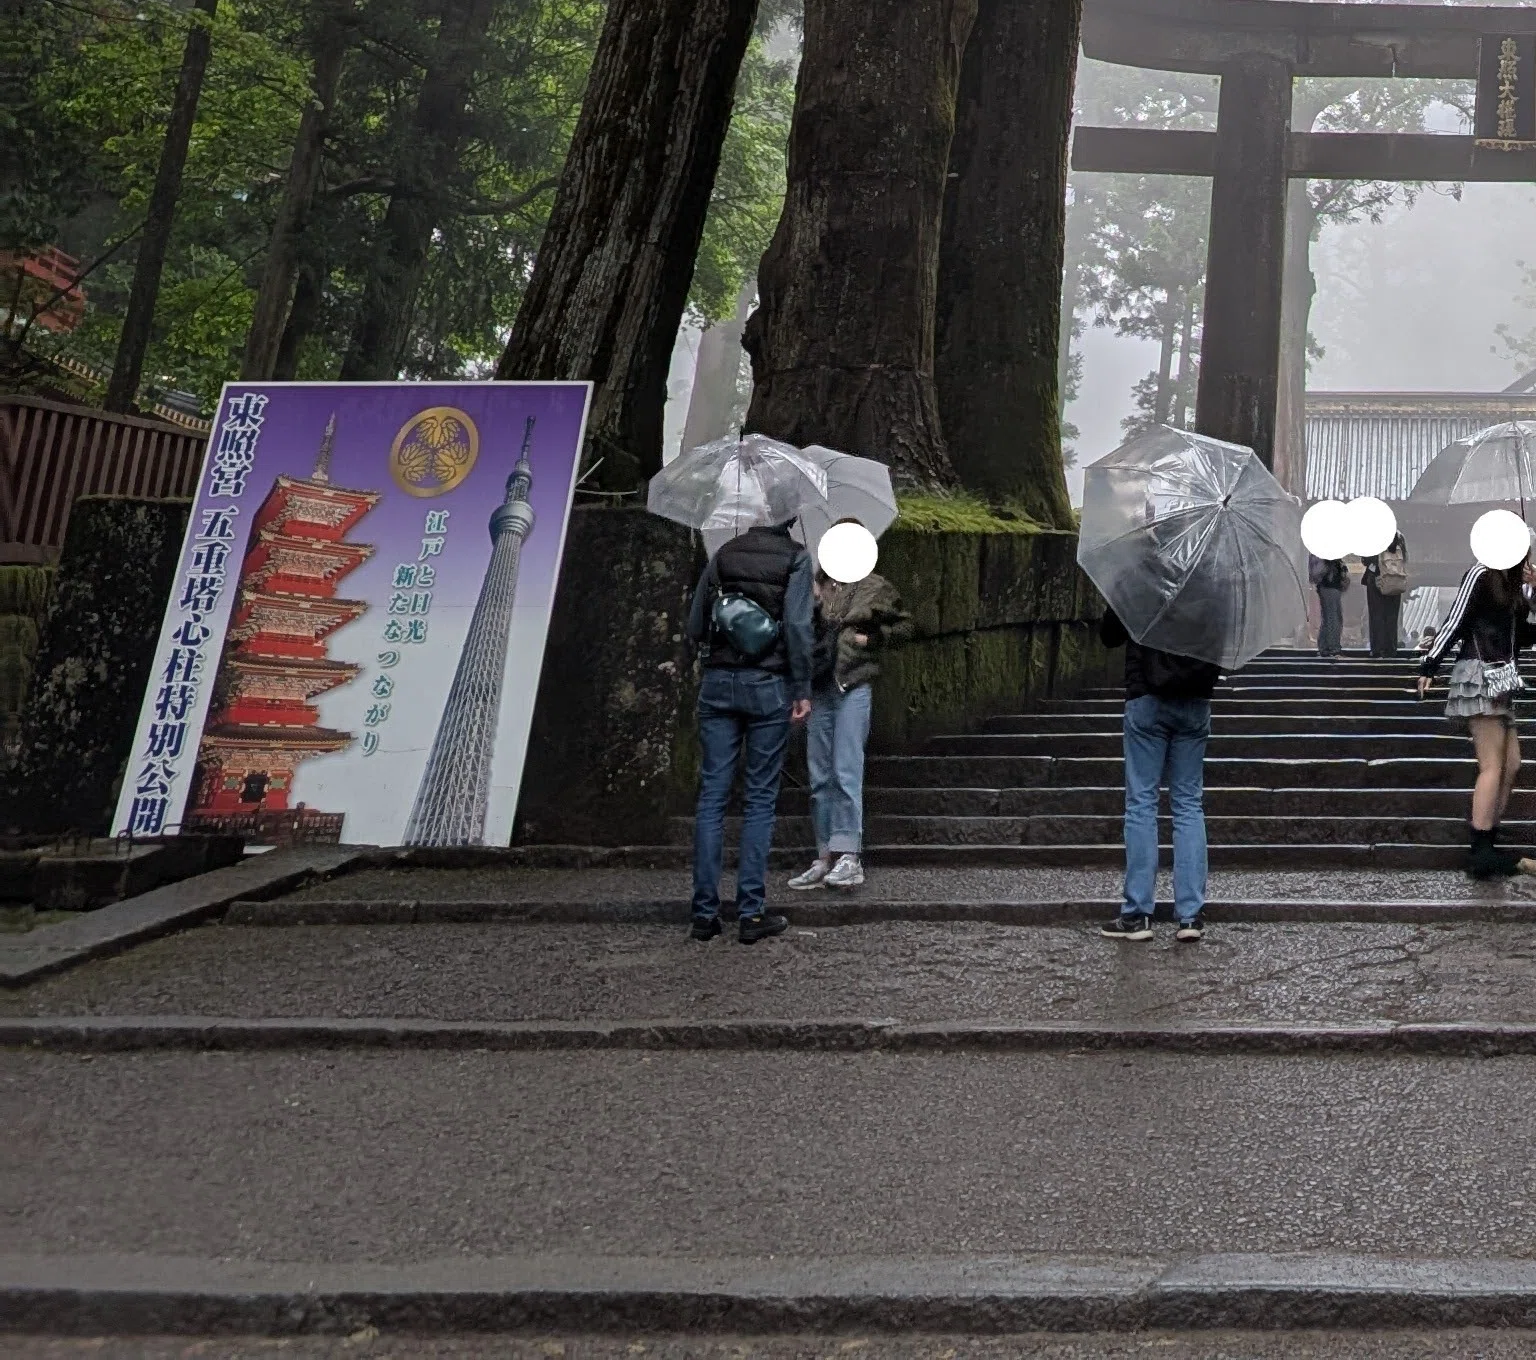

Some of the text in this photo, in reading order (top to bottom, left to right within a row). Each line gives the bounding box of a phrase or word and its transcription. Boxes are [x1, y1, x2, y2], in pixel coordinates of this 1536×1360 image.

[128, 393, 269, 835] 東照宮 五重塔心柱特別公開
[362, 564, 418, 756] 新たなつながり
[402, 510, 450, 642] 江戸と日光
